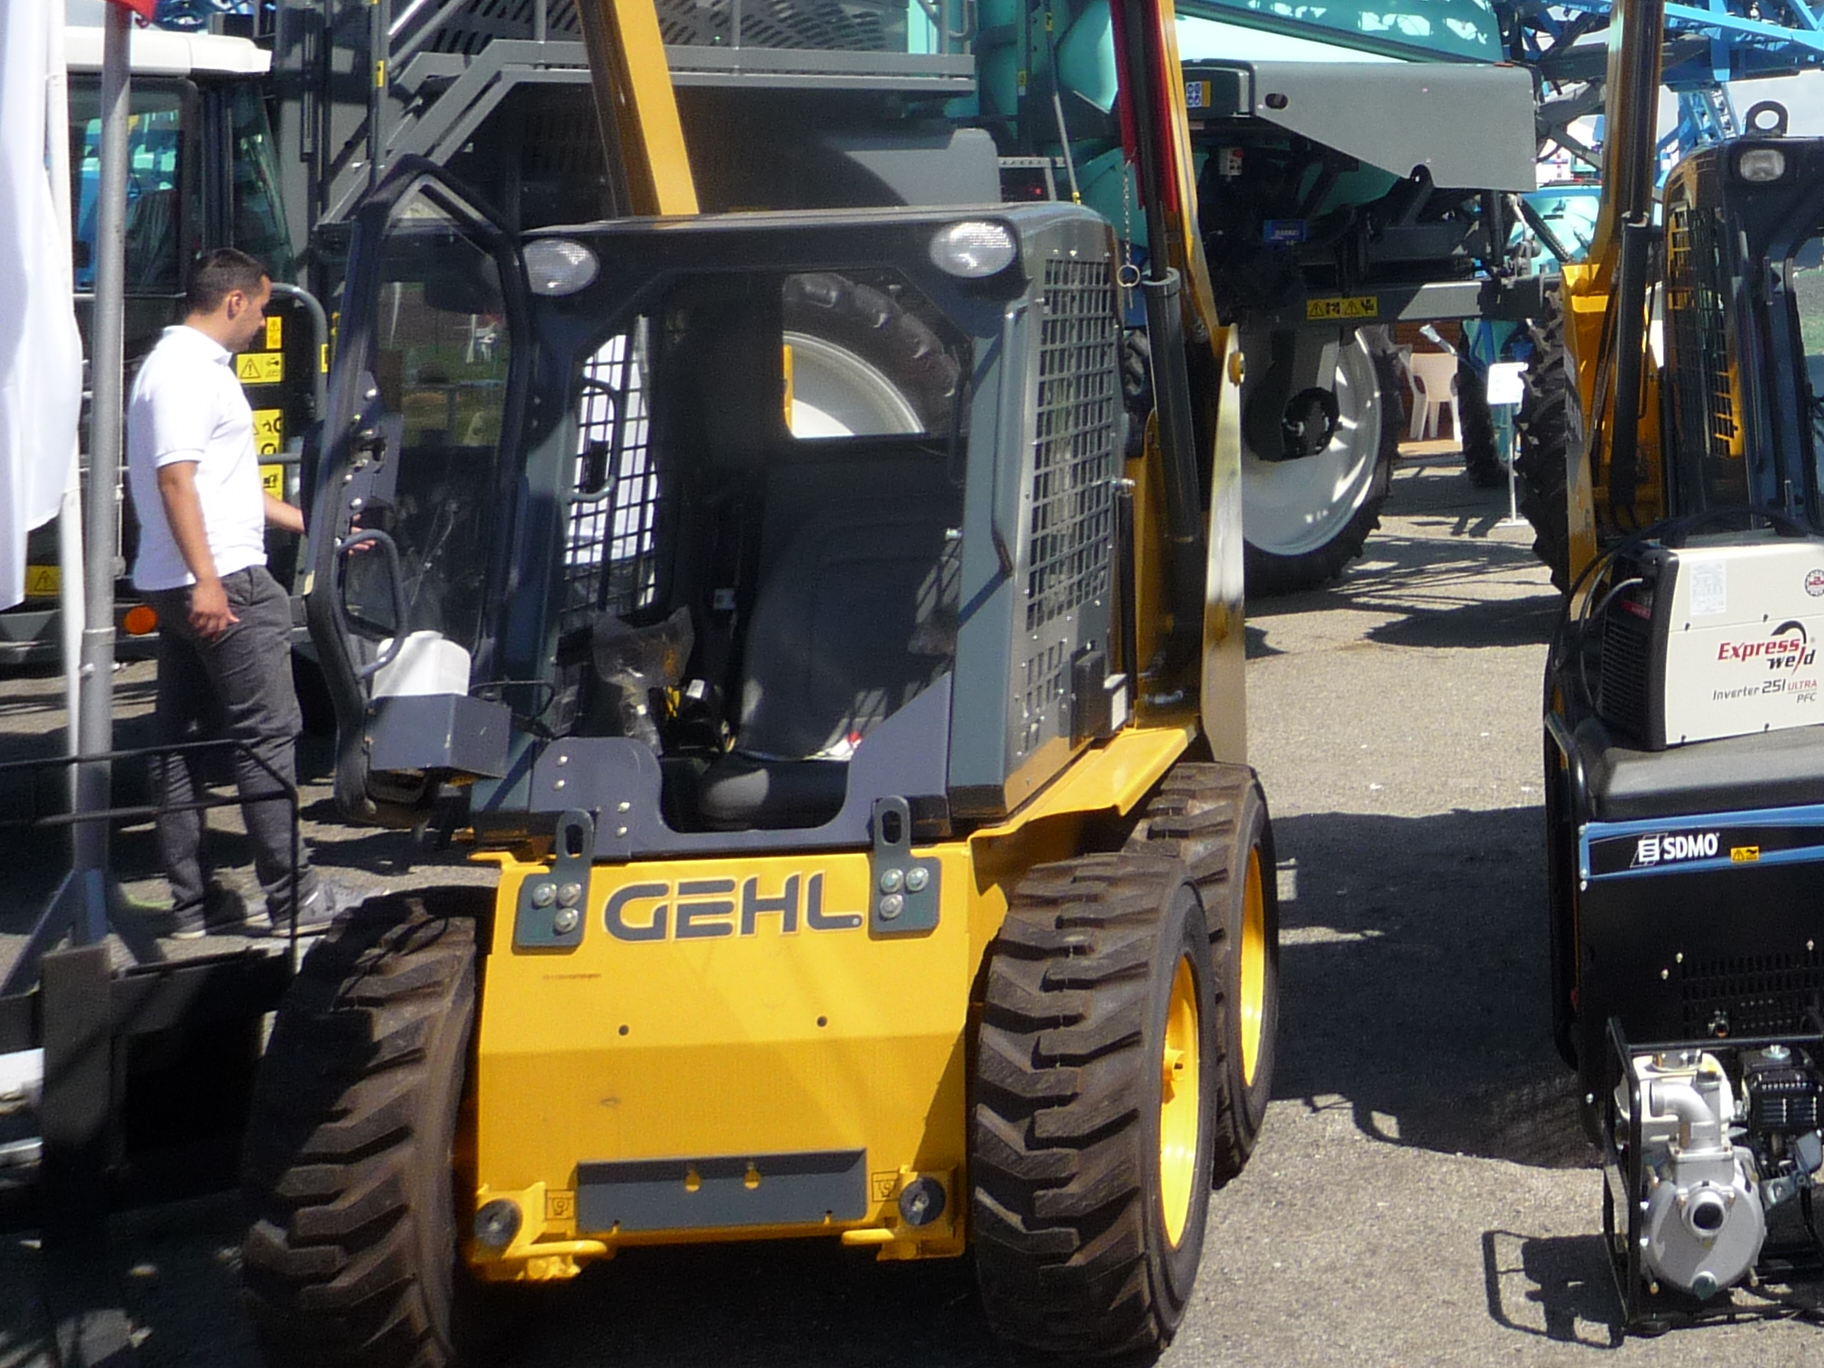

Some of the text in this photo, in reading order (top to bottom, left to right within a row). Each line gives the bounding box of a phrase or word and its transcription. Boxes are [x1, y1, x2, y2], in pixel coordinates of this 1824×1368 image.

[1717, 638, 1801, 662] Express
[1766, 646, 1816, 674] weld
[1712, 678, 1817, 701] Inverter 251 ULTRA
[1796, 692, 1817, 704] PFC
[1663, 835, 1718, 860] SDMO
[604, 872, 863, 943] GEHL
